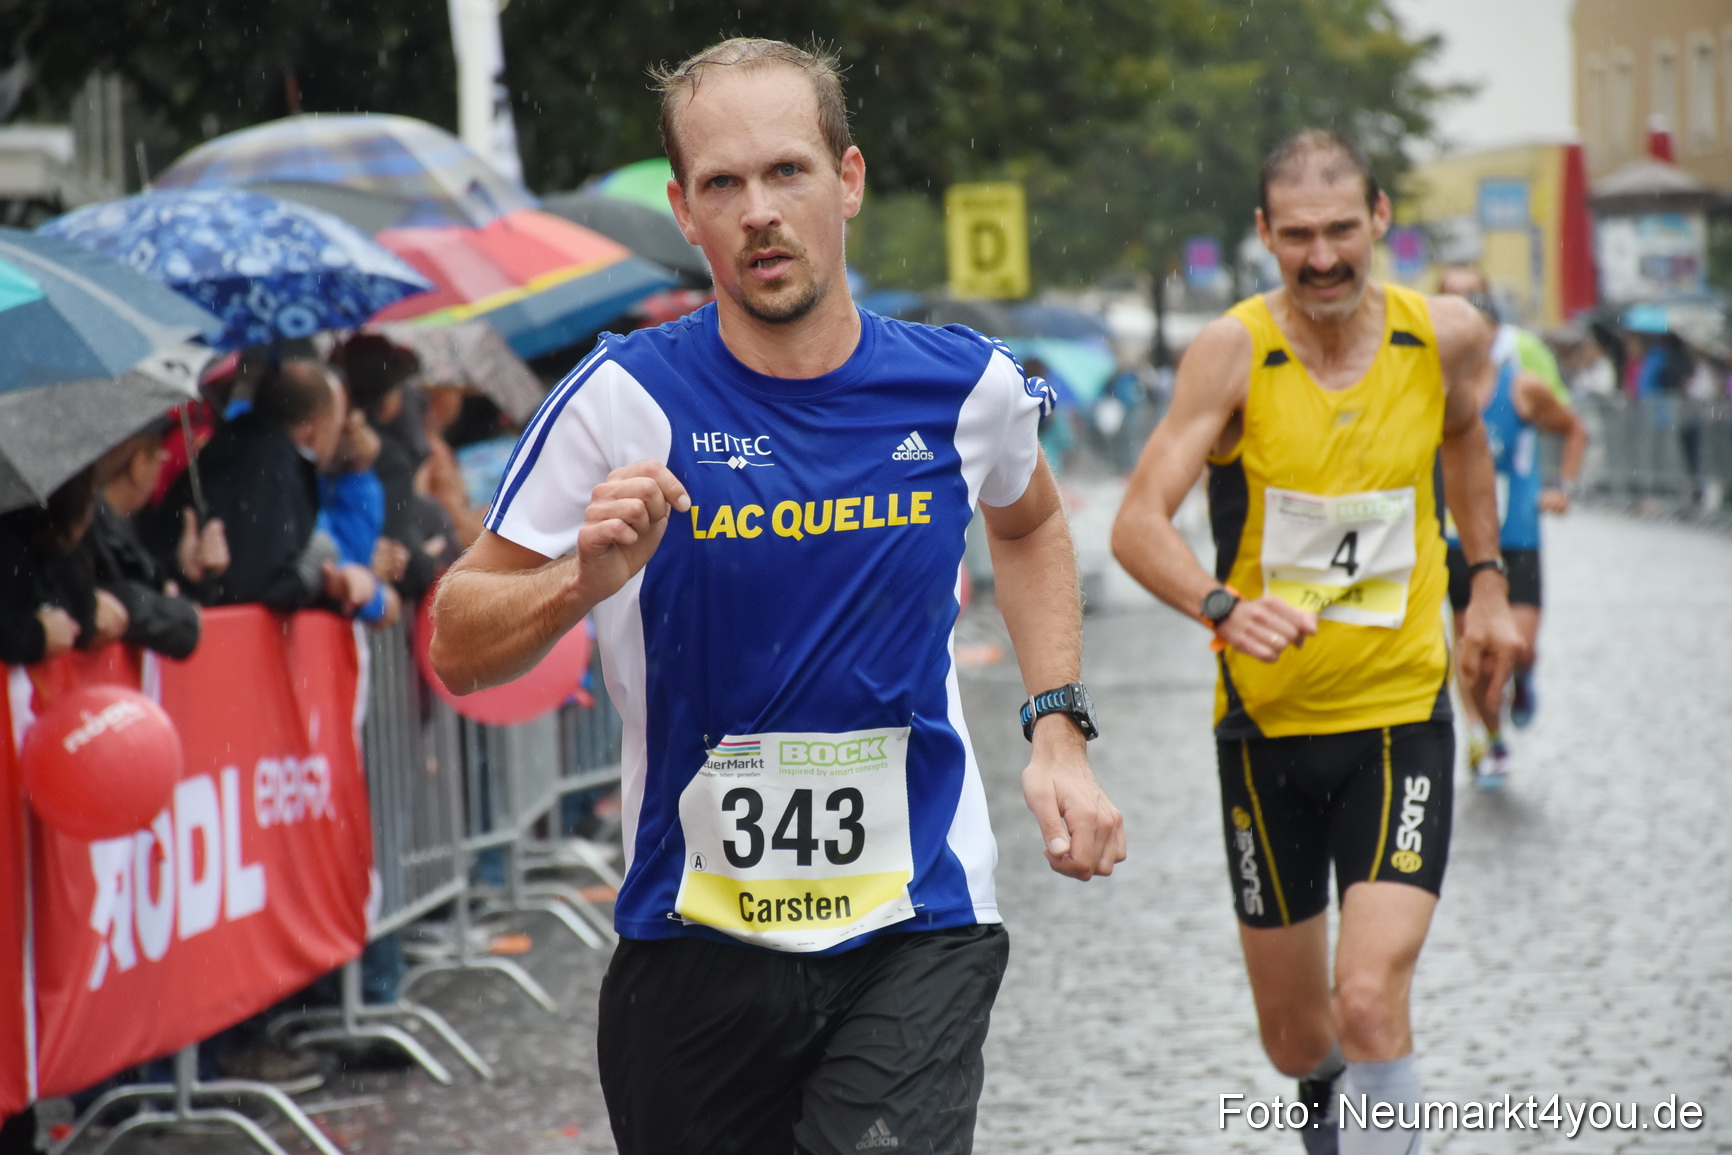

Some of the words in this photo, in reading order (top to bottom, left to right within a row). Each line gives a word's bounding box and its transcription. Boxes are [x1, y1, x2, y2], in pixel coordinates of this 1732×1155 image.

[692, 432, 773, 457] HEITEC
[892, 449, 934, 461] adidas
[691, 504, 765, 539] LAC
[771, 491, 932, 541] QUELLE
[1331, 530, 1359, 577] 4
[703, 758, 765, 770] euerMarkt
[778, 736, 889, 767] BOCK
[778, 767, 815, 777] inspired
[816, 768, 828, 777] by
[829, 767, 854, 776] smart
[855, 761, 889, 773] concepts
[721, 787, 866, 869] 343
[694, 855, 703, 869] A
[738, 892, 852, 923] Carsten
